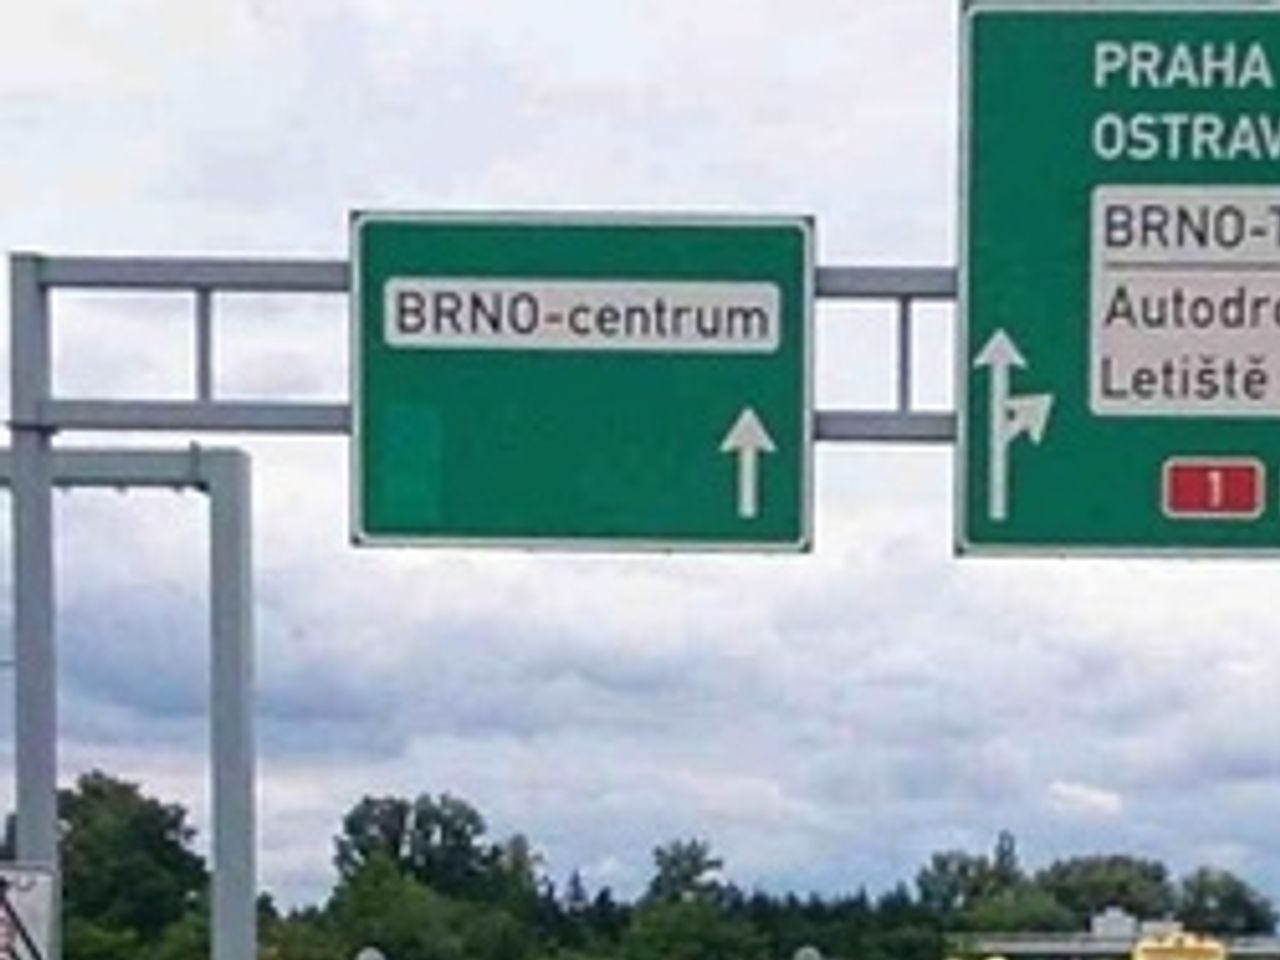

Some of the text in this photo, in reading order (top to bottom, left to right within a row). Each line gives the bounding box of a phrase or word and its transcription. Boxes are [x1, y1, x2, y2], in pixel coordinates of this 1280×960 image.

[1093, 41, 1275, 89] PRAHA
[396, 290, 770, 340] BRNO-centrum
[1101, 354, 1269, 401] Letiště
[1207, 470, 1222, 508] 1
